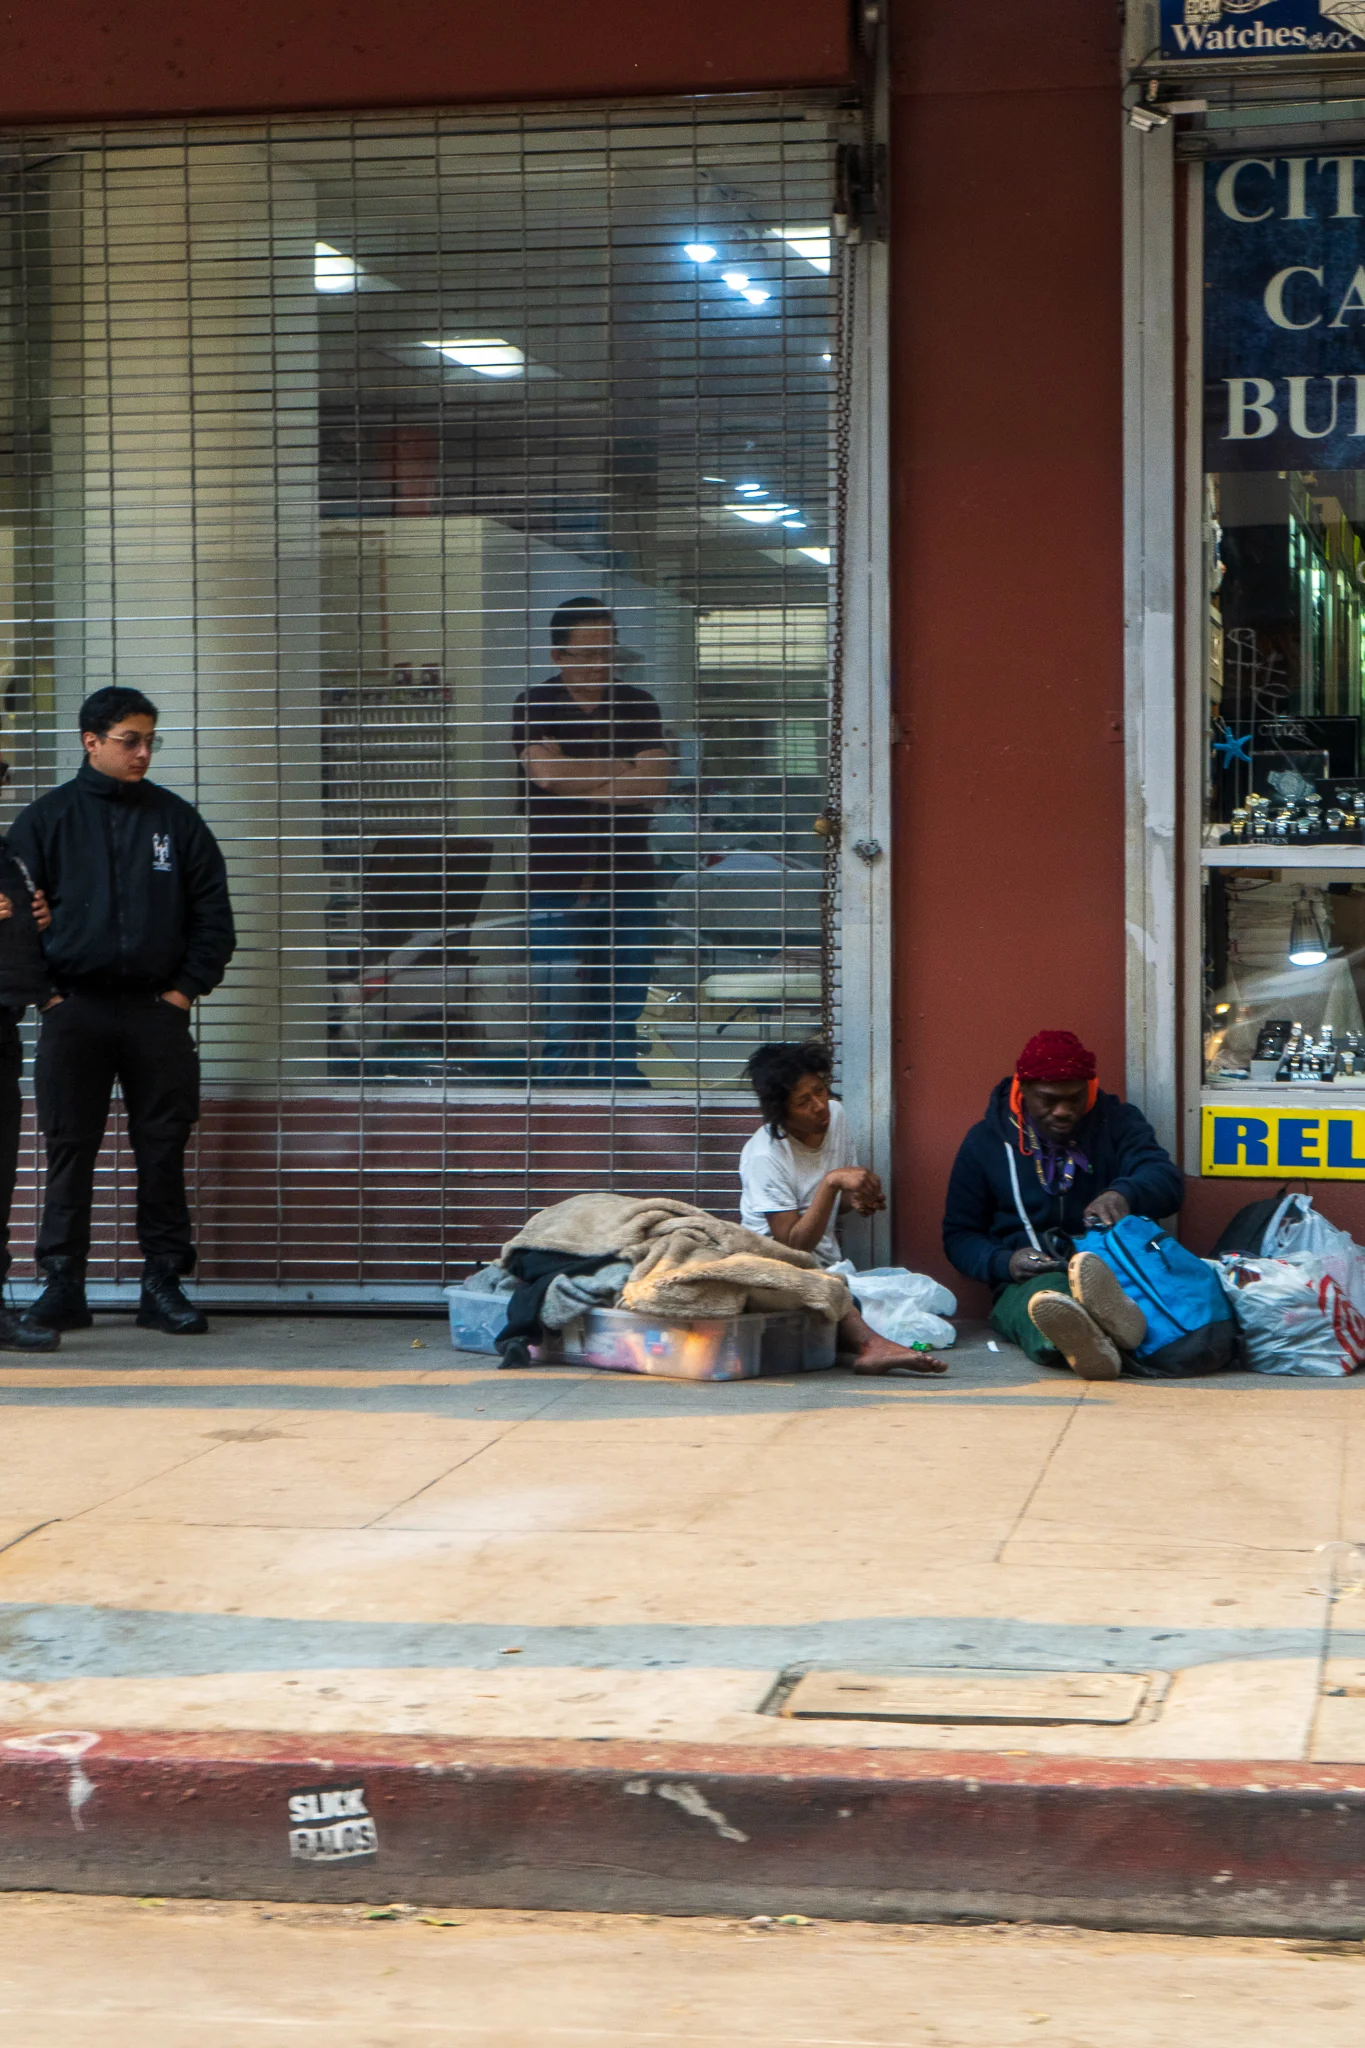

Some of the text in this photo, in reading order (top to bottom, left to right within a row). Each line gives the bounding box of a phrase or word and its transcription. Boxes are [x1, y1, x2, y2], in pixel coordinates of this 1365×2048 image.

[1171, 20, 1307, 51] Watches
[1215, 156, 1365, 223] CIT
[1213, 1116, 1365, 1168] REL
